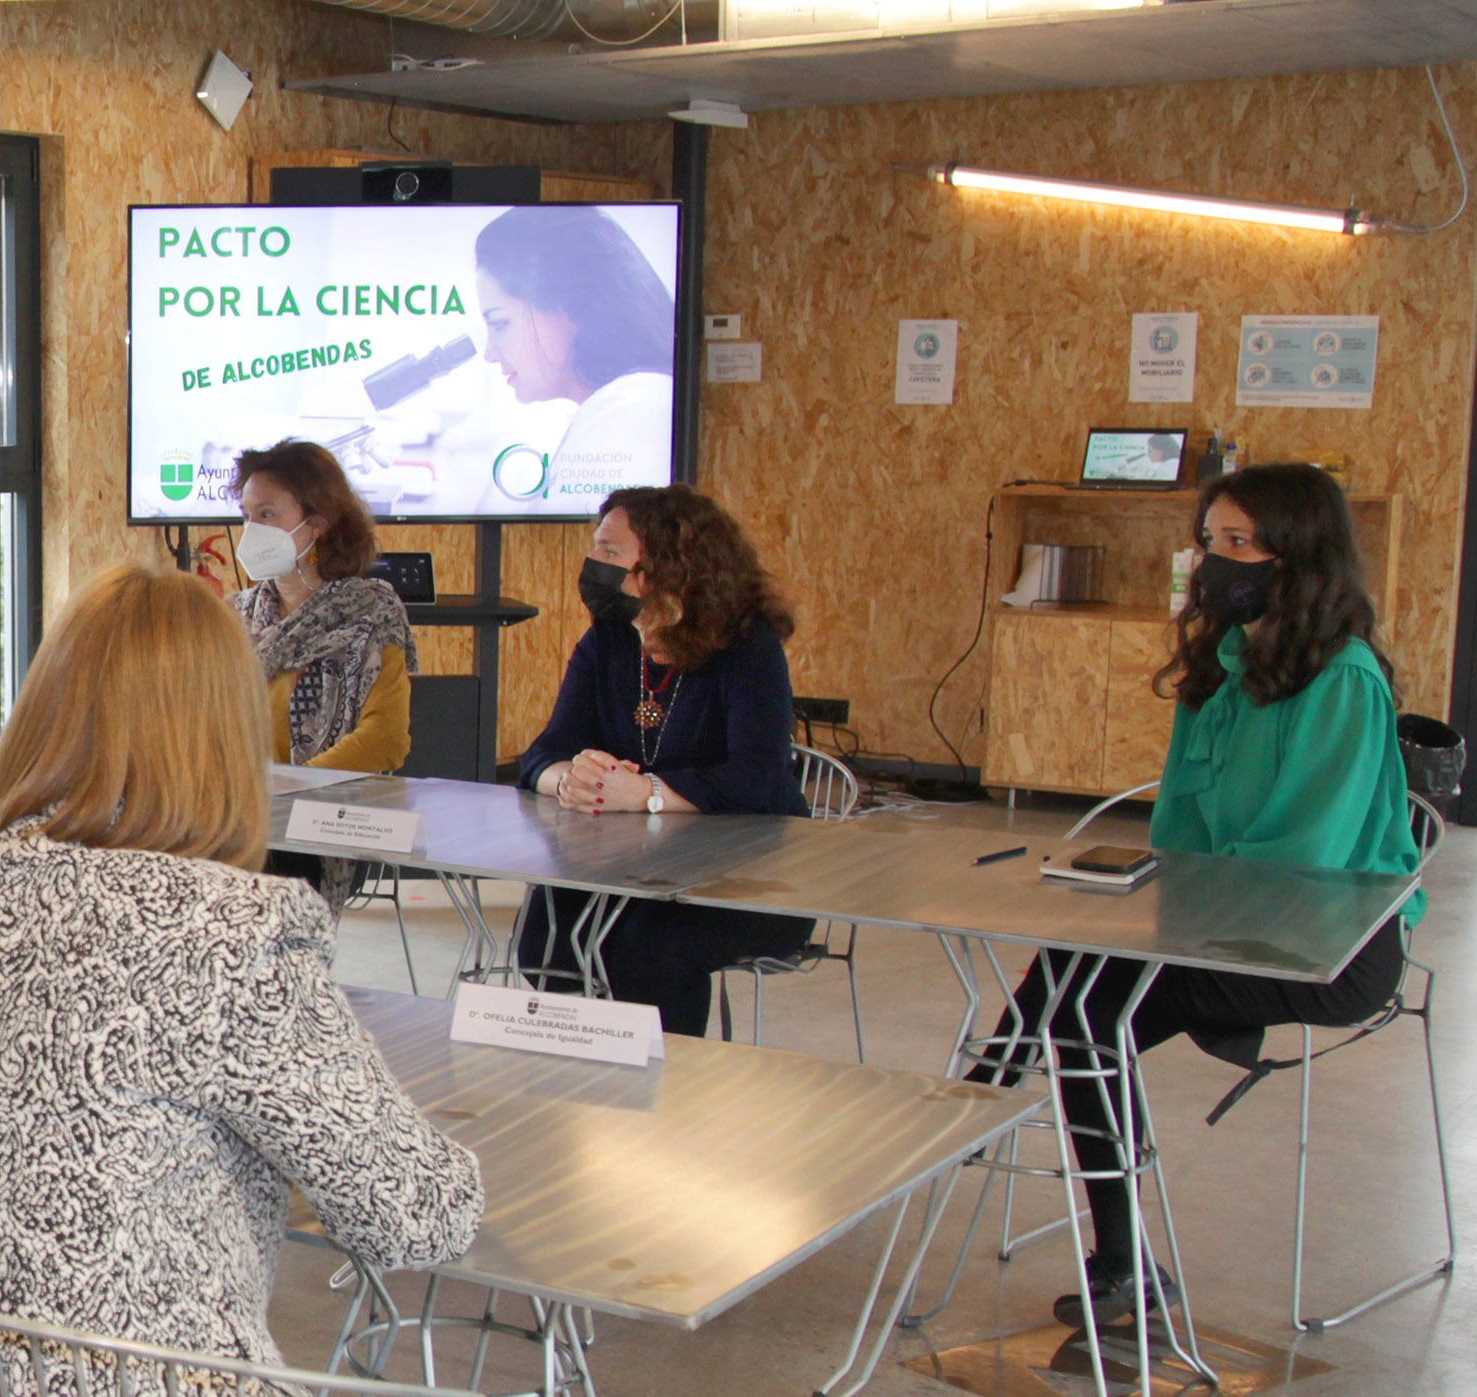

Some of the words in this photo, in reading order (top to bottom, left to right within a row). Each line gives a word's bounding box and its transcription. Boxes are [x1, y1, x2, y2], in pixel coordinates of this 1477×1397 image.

[159, 226, 291, 258] PACTO
[159, 286, 241, 318] POR
[257, 286, 301, 318] LA
[316, 284, 467, 316] CIENCIA
[182, 366, 212, 392] DE
[222, 338, 374, 385] ALCOBENDAS
[560, 451, 633, 463] FUNDACIÓN
[560, 468, 605, 479] CIUDAD
[609, 468, 624, 479] DE
[321, 820, 335, 828] ANA
[357, 824, 393, 835] MONTALVO
[483, 1012, 516, 1024] OFELIA
[517, 1016, 580, 1033] CULEBRADAS
[581, 1025, 635, 1040] BACHILLER
[505, 1026, 544, 1041] Concejala
[546, 1031, 556, 1041] de
[558, 1032, 593, 1046] Igualdad
